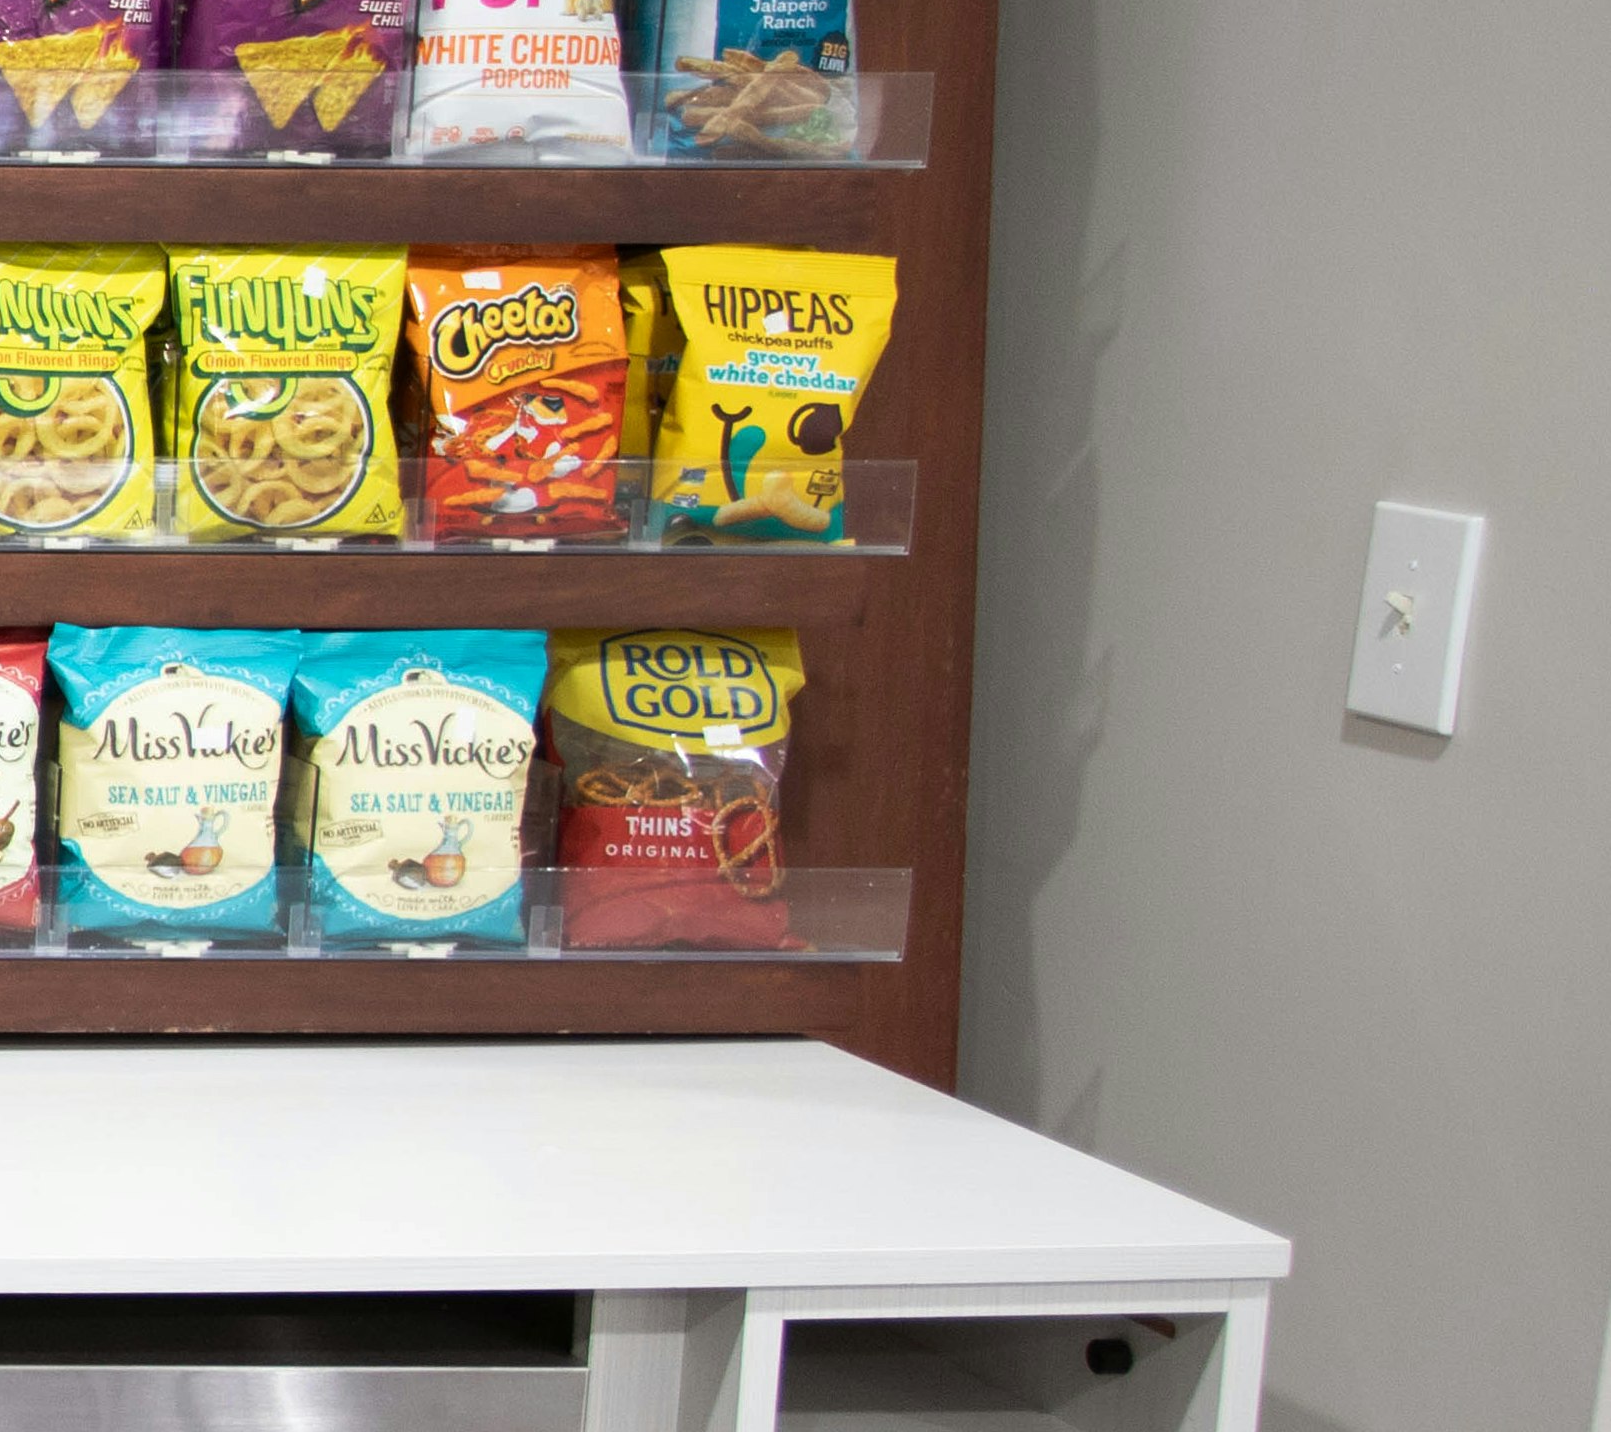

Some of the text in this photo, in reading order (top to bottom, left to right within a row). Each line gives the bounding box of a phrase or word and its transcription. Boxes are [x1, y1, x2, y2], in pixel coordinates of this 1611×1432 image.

[763, 15, 816, 30] Ranch
[822, 42, 848, 58] BIG
[481, 69, 570, 90] POPCORN
[704, 284, 854, 336] HIPPEAS
[433, 286, 575, 374] Cheetos
[15, 351, 74, 367] Flavored
[77, 353, 117, 369] Rings
[205, 354, 353, 370] Onion Flavored Rings
[708, 365, 857, 393] white cheddar
[623, 643, 754, 681] ROLD
[626, 685, 763, 720] GOLD
[625, 816, 692, 837] THINS
[605, 844, 709, 859] ORIGINAL
